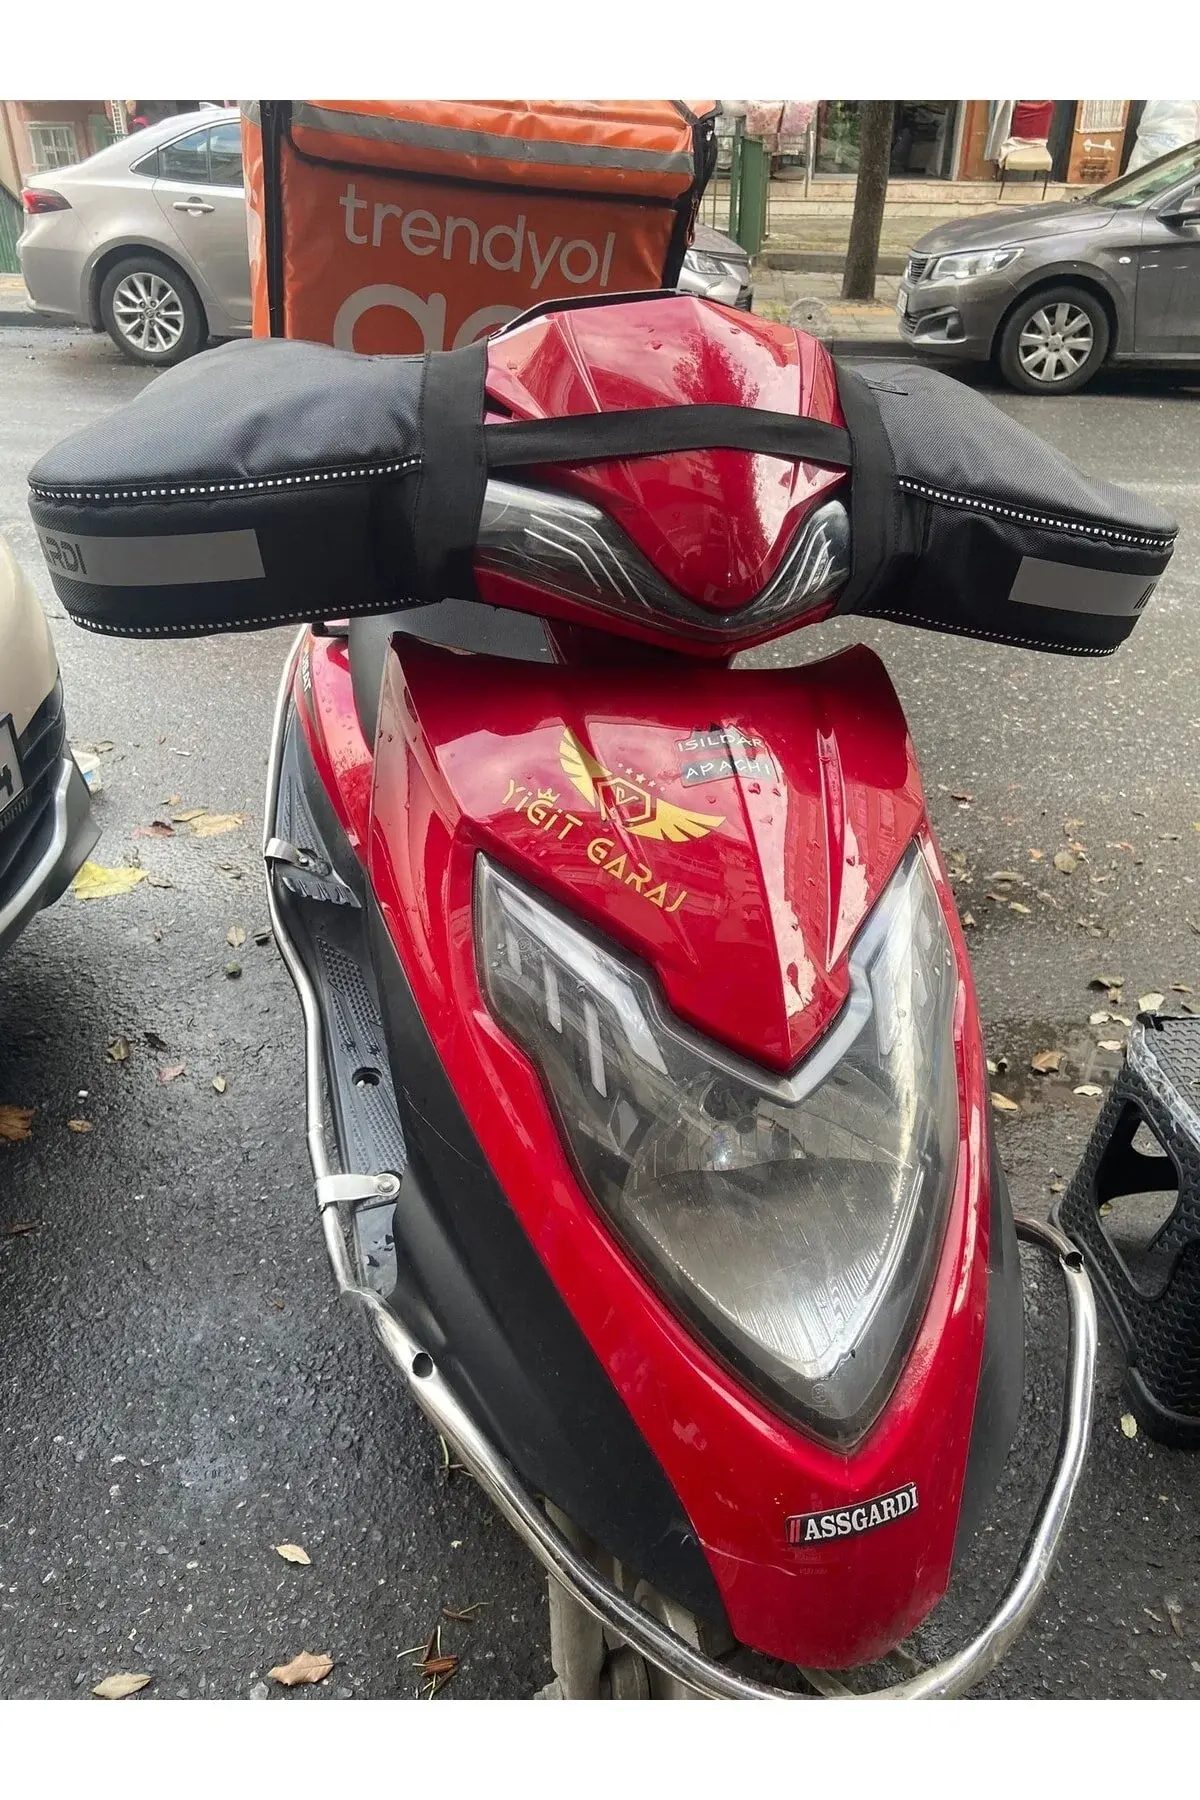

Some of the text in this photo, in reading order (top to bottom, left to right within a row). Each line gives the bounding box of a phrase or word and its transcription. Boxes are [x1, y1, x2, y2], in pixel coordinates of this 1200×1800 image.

[339, 184, 616, 289] trendyol
[678, 734, 764, 752] ISILDAR
[686, 759, 771, 779] APACHI
[586, 837, 688, 913] GARAJ
[804, 1486, 919, 1541] ASSGARDI
